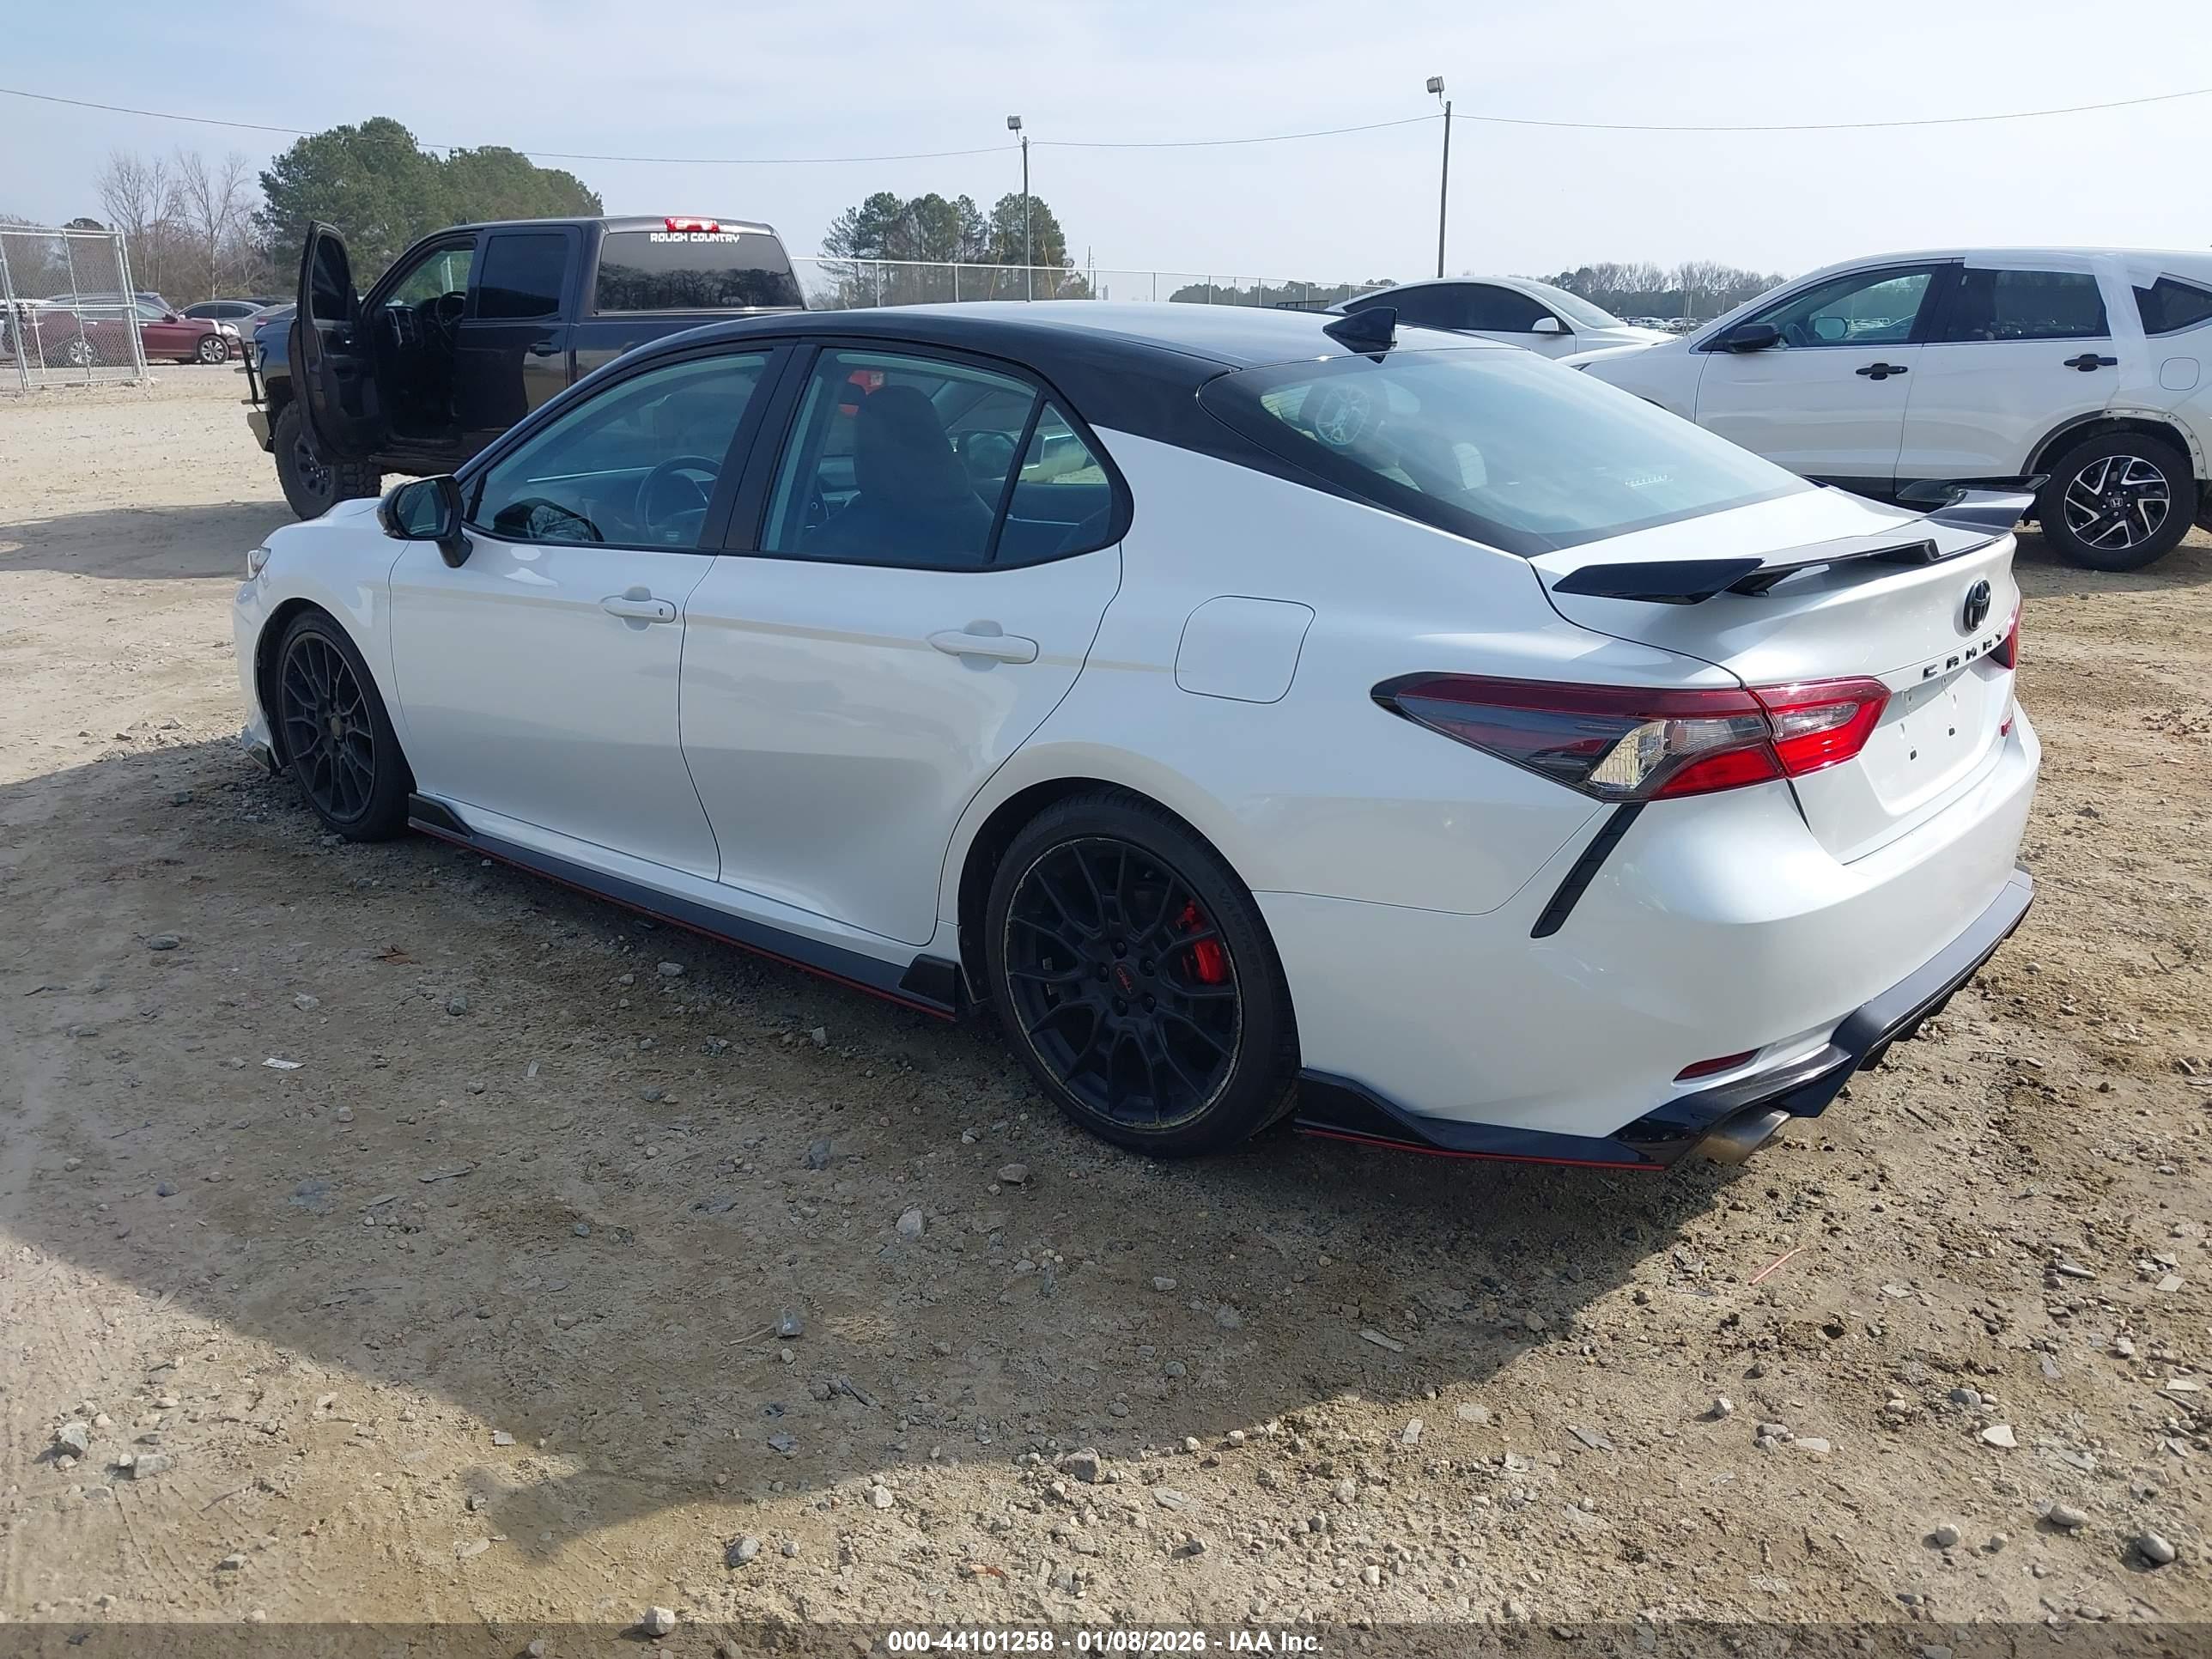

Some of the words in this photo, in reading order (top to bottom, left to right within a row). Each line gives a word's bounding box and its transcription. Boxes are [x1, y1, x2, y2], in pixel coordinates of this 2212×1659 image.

[650, 233, 688, 242] ROUGH
[690, 233, 740, 243] COUNTRY
[1923, 630, 2003, 679] CAMRY
